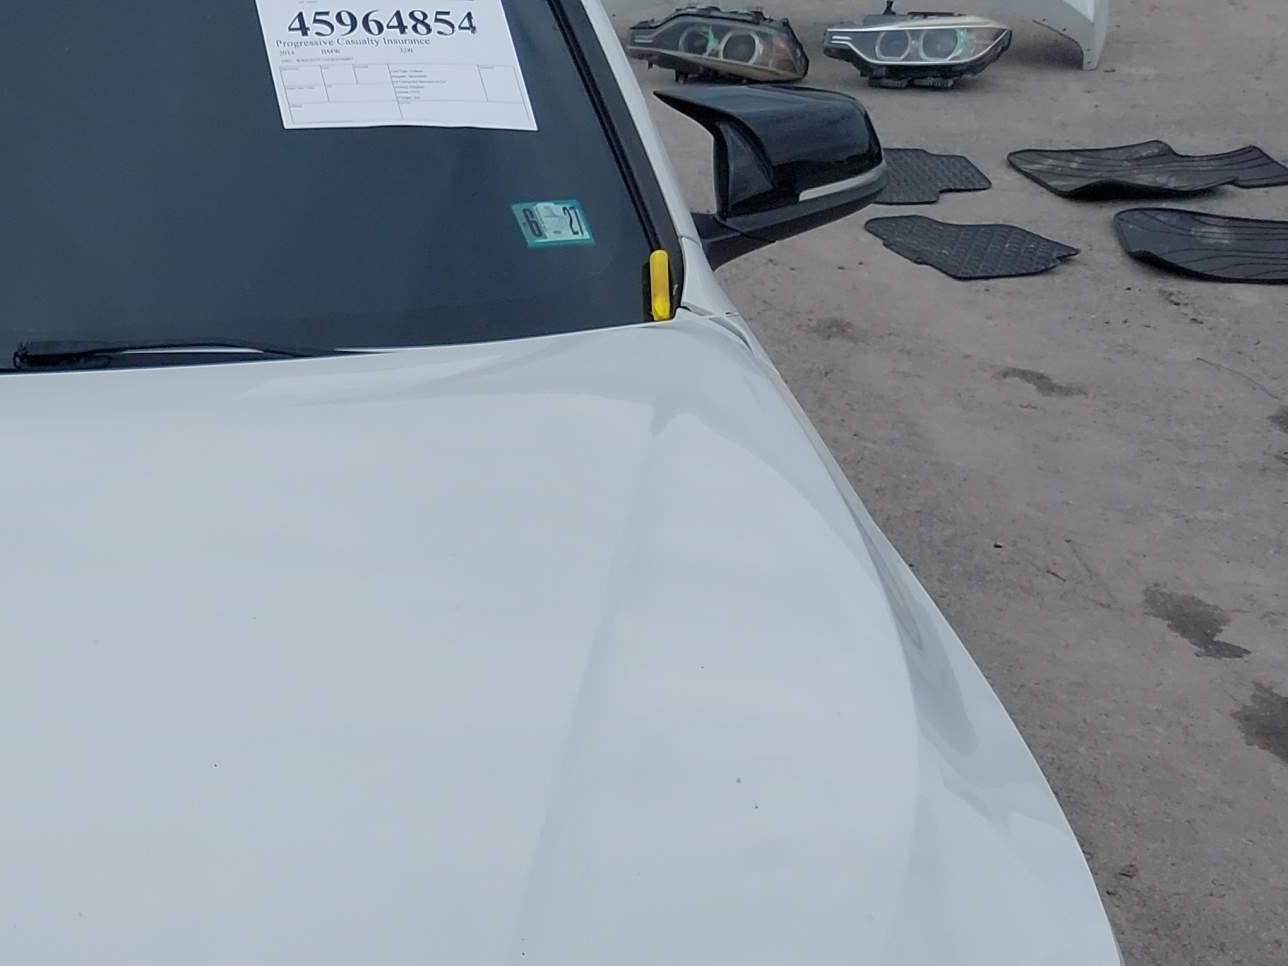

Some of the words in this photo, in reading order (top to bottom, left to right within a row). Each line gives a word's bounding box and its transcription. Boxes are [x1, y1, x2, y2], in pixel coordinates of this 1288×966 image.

[287, 9, 477, 37] 45964854
[275, 39, 334, 49] Progressive
[336, 37, 380, 47] Casualty
[382, 36, 431, 46] Insurance
